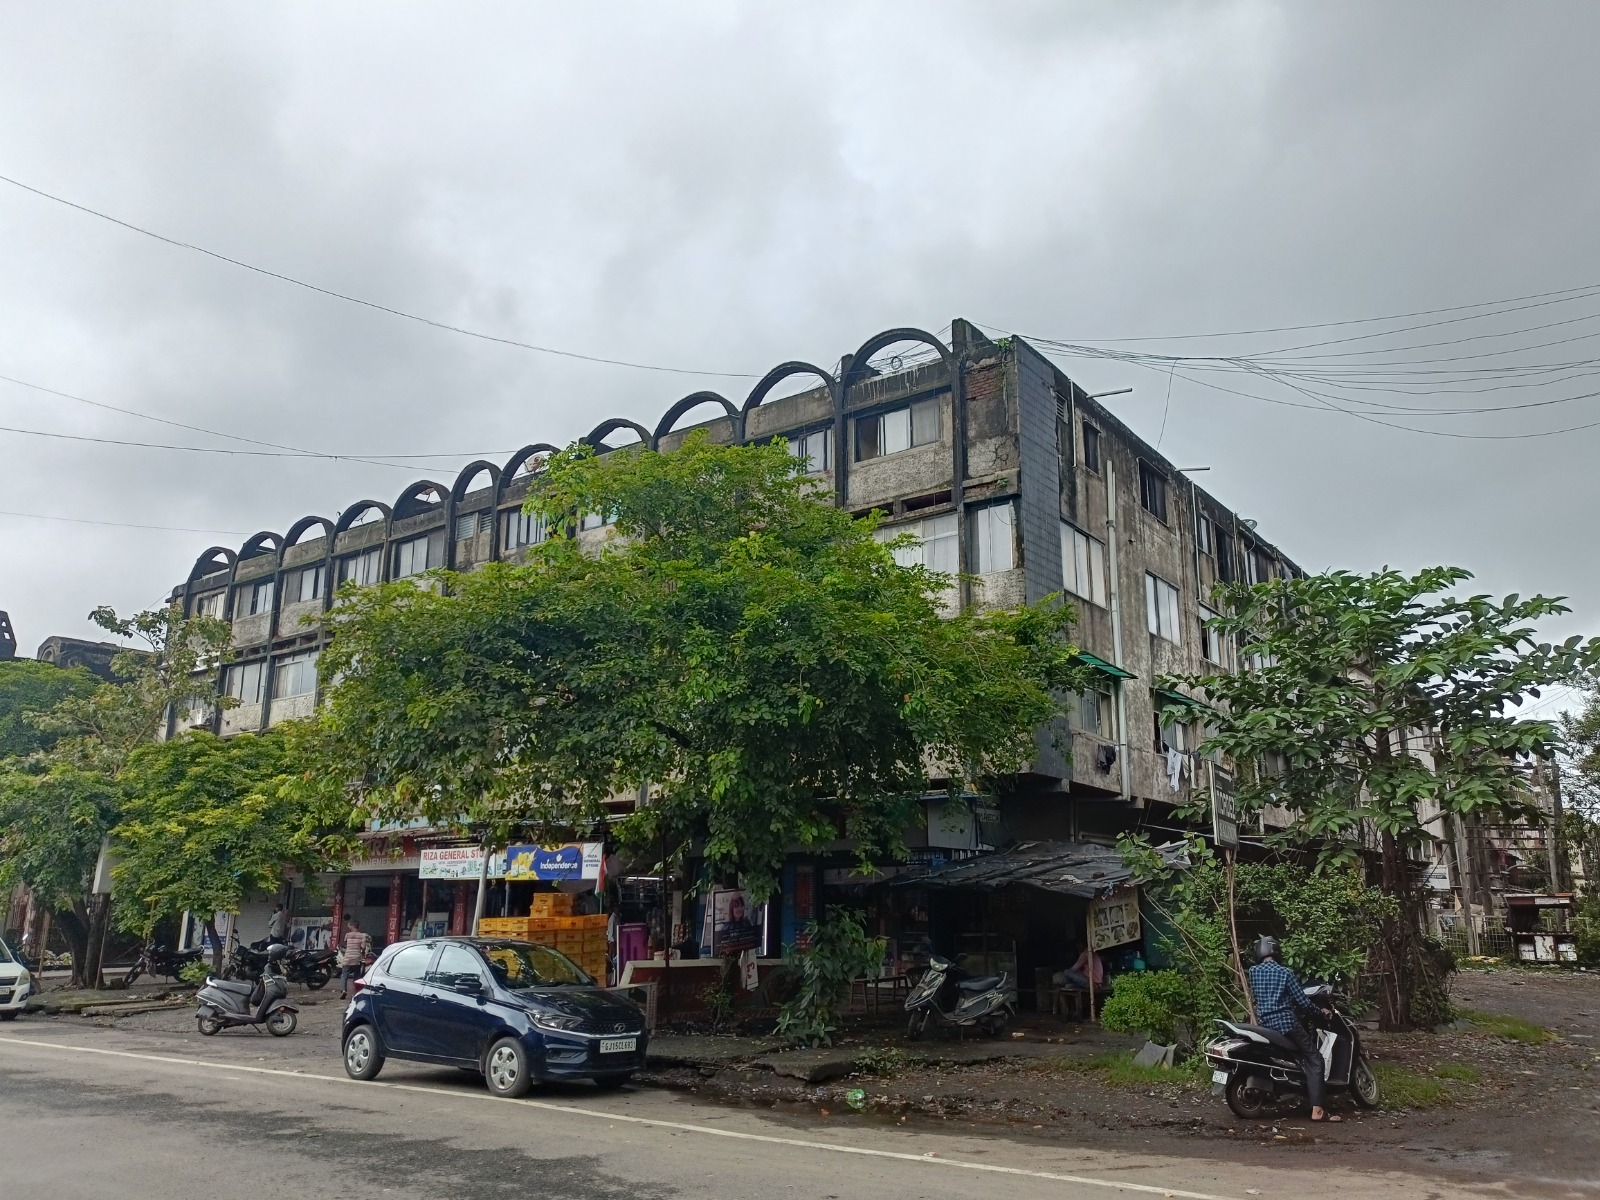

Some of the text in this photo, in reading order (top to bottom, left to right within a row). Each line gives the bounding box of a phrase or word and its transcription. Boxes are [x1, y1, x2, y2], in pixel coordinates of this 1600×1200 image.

[423, 848, 484, 861] RIZA GENERAL STO
[367, 857, 400, 867] GENERL
[540, 859, 578, 870] Independence
